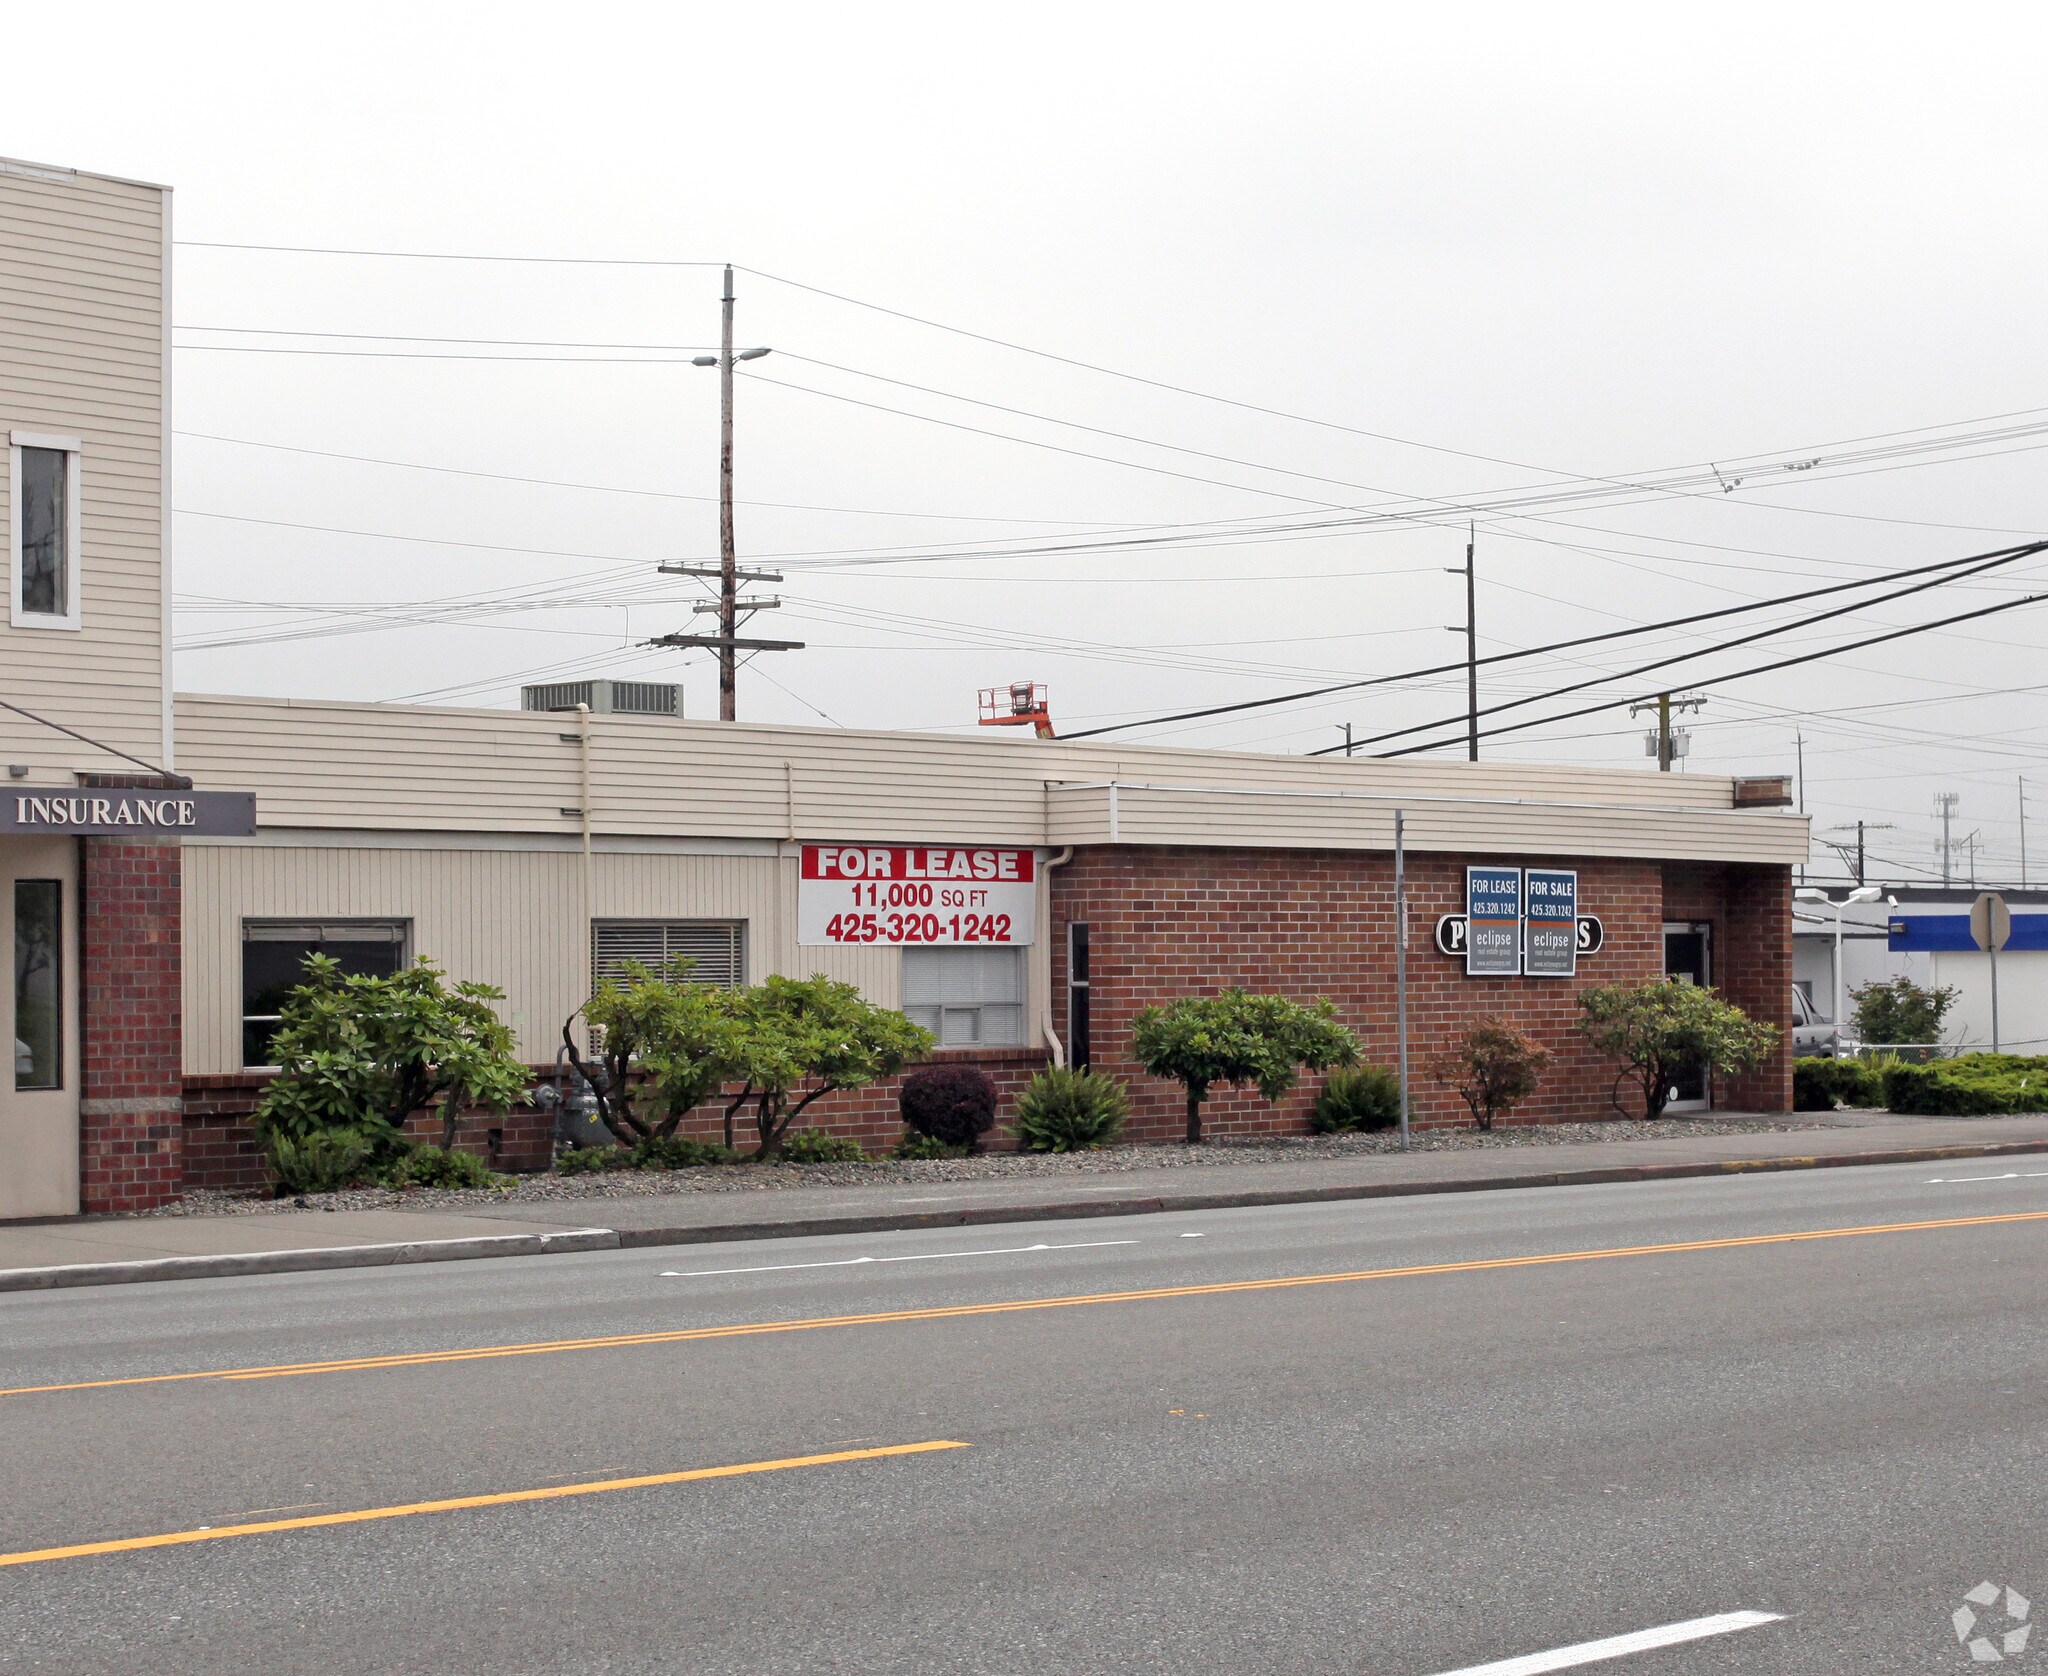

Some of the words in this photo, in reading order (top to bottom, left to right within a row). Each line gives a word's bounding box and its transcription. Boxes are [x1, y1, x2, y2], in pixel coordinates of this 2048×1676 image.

[15, 797, 196, 827] INSURANCE
[817, 848, 892, 878] FOR
[905, 850, 1019, 879] LEASE
[1472, 879, 1489, 894] FOR
[1491, 880, 1516, 894] LEASE
[1530, 881, 1548, 896] FOR
[1550, 882, 1573, 896] SALE
[851, 883, 933, 912] 11,000
[941, 889, 964, 907] SQ
[970, 890, 988, 907] FT
[1473, 902, 1516, 915] 425.320.1242
[1531, 904, 1572, 917] 425.320.1242
[825, 913, 1011, 942] 425-320-1242
[1476, 930, 1511, 948] eclipse
[1534, 932, 1569, 950] eclipse
